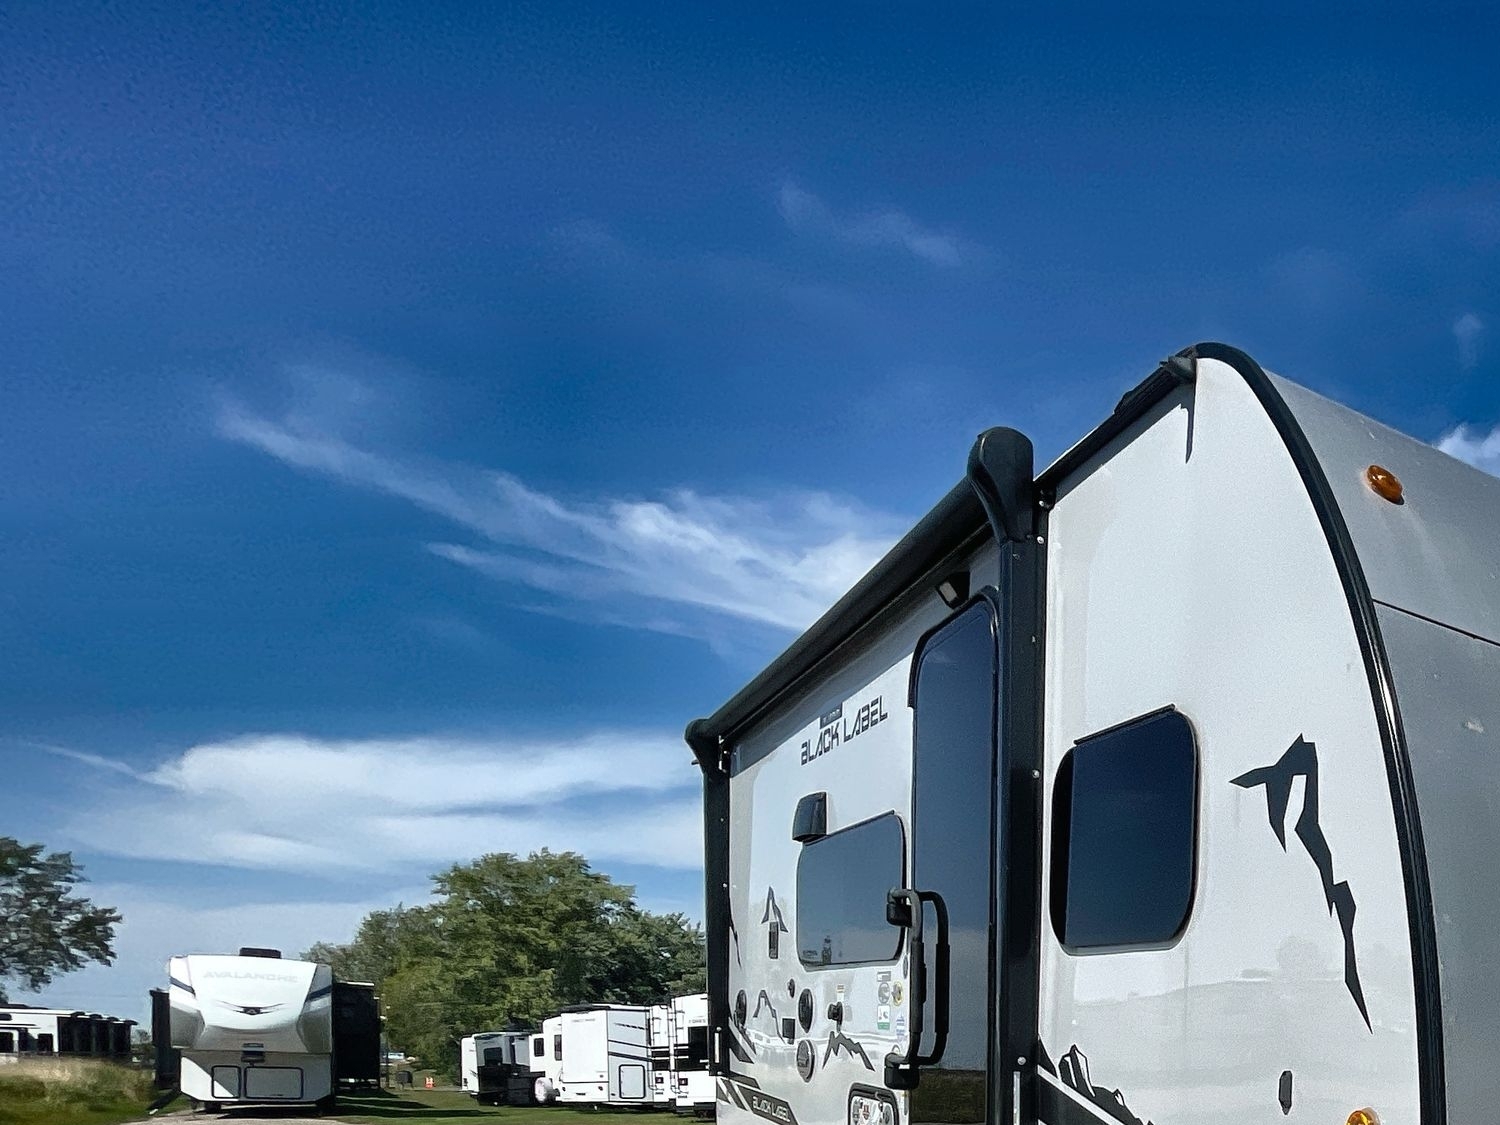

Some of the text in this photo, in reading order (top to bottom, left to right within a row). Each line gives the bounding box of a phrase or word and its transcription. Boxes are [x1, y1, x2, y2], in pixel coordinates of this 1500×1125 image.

[801, 721, 840, 766] BLACK
[843, 695, 888, 743] LABEL
[203, 971, 298, 983] AVALANCHE
